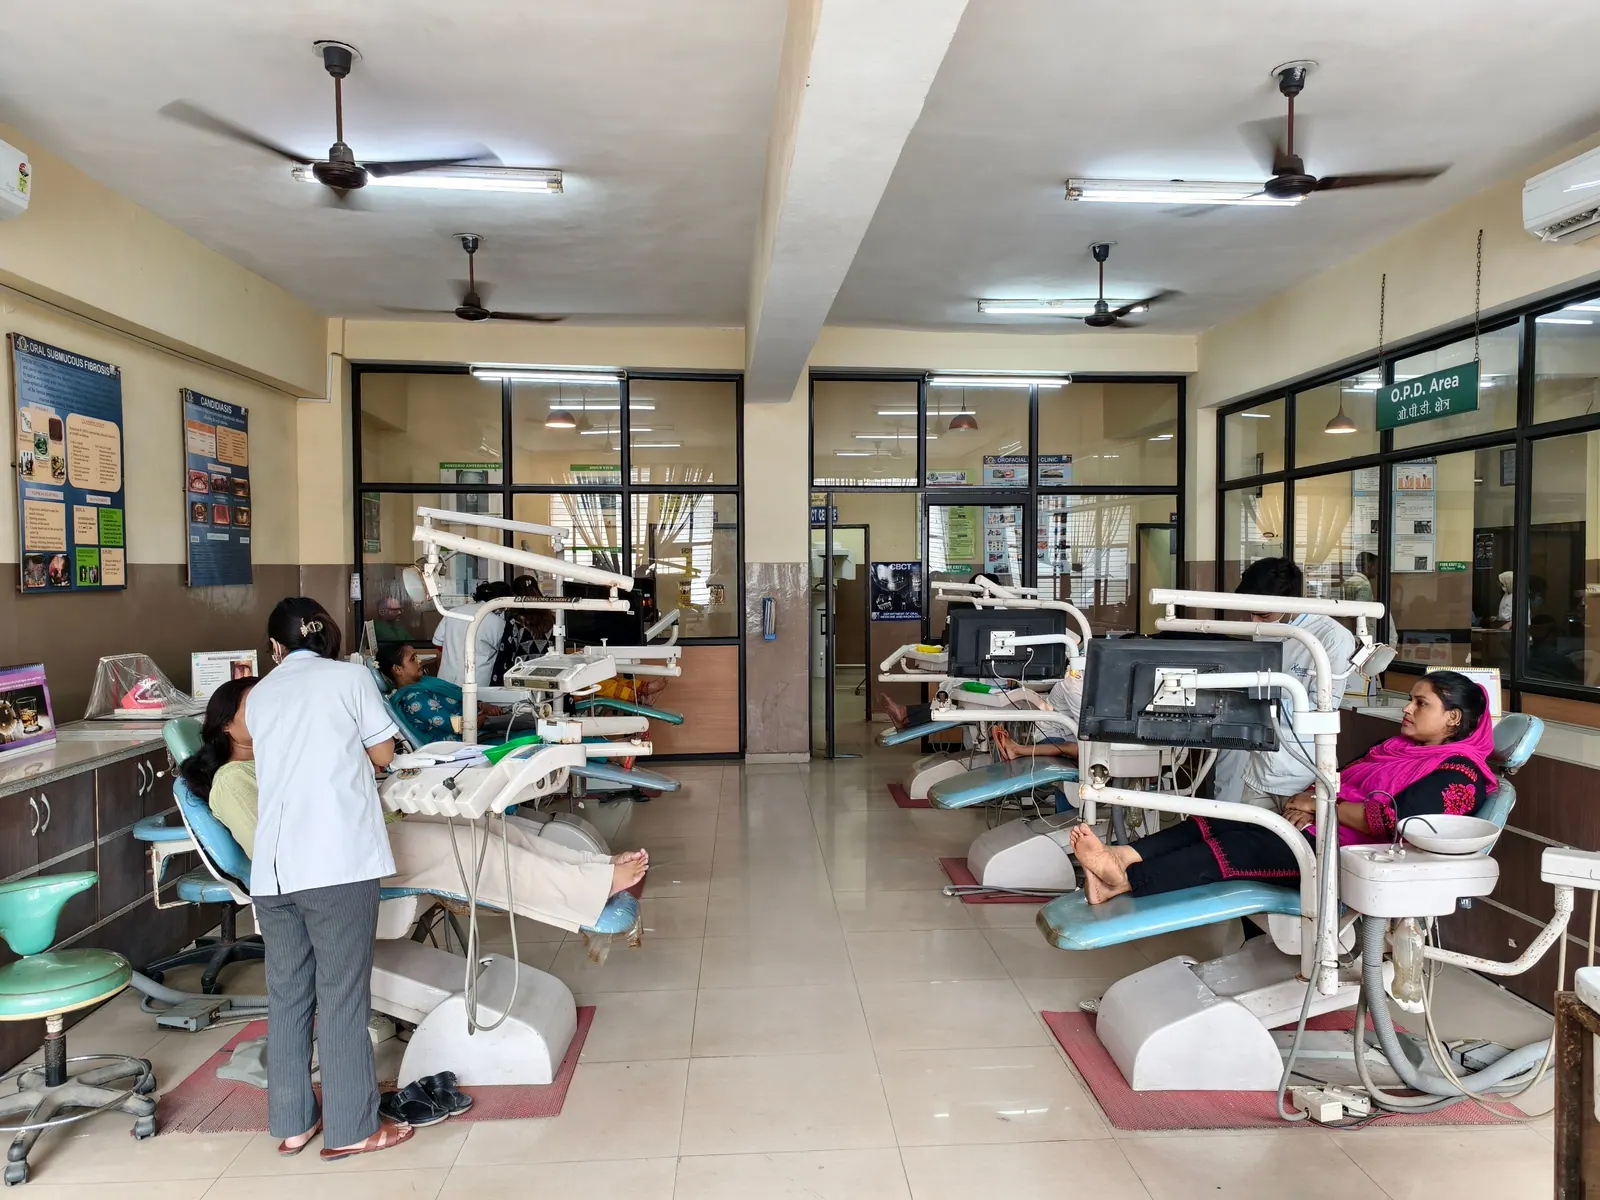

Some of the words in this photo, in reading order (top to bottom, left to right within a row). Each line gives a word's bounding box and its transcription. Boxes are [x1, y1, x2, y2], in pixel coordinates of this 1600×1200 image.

[29, 342, 46, 357] ORAL
[46, 348, 84, 368] SUBMUCOUS
[84, 360, 110, 376] FIBROSIS
[1391, 382, 1426, 403] O.P.D.
[1429, 375, 1460, 394] Area
[200, 396, 232, 414] CANDIDIASIS
[1397, 399, 1432, 421] ओ.पी.डी.
[1435, 396, 1451, 413] क्षेत्र
[889, 563, 912, 571] CBCT
